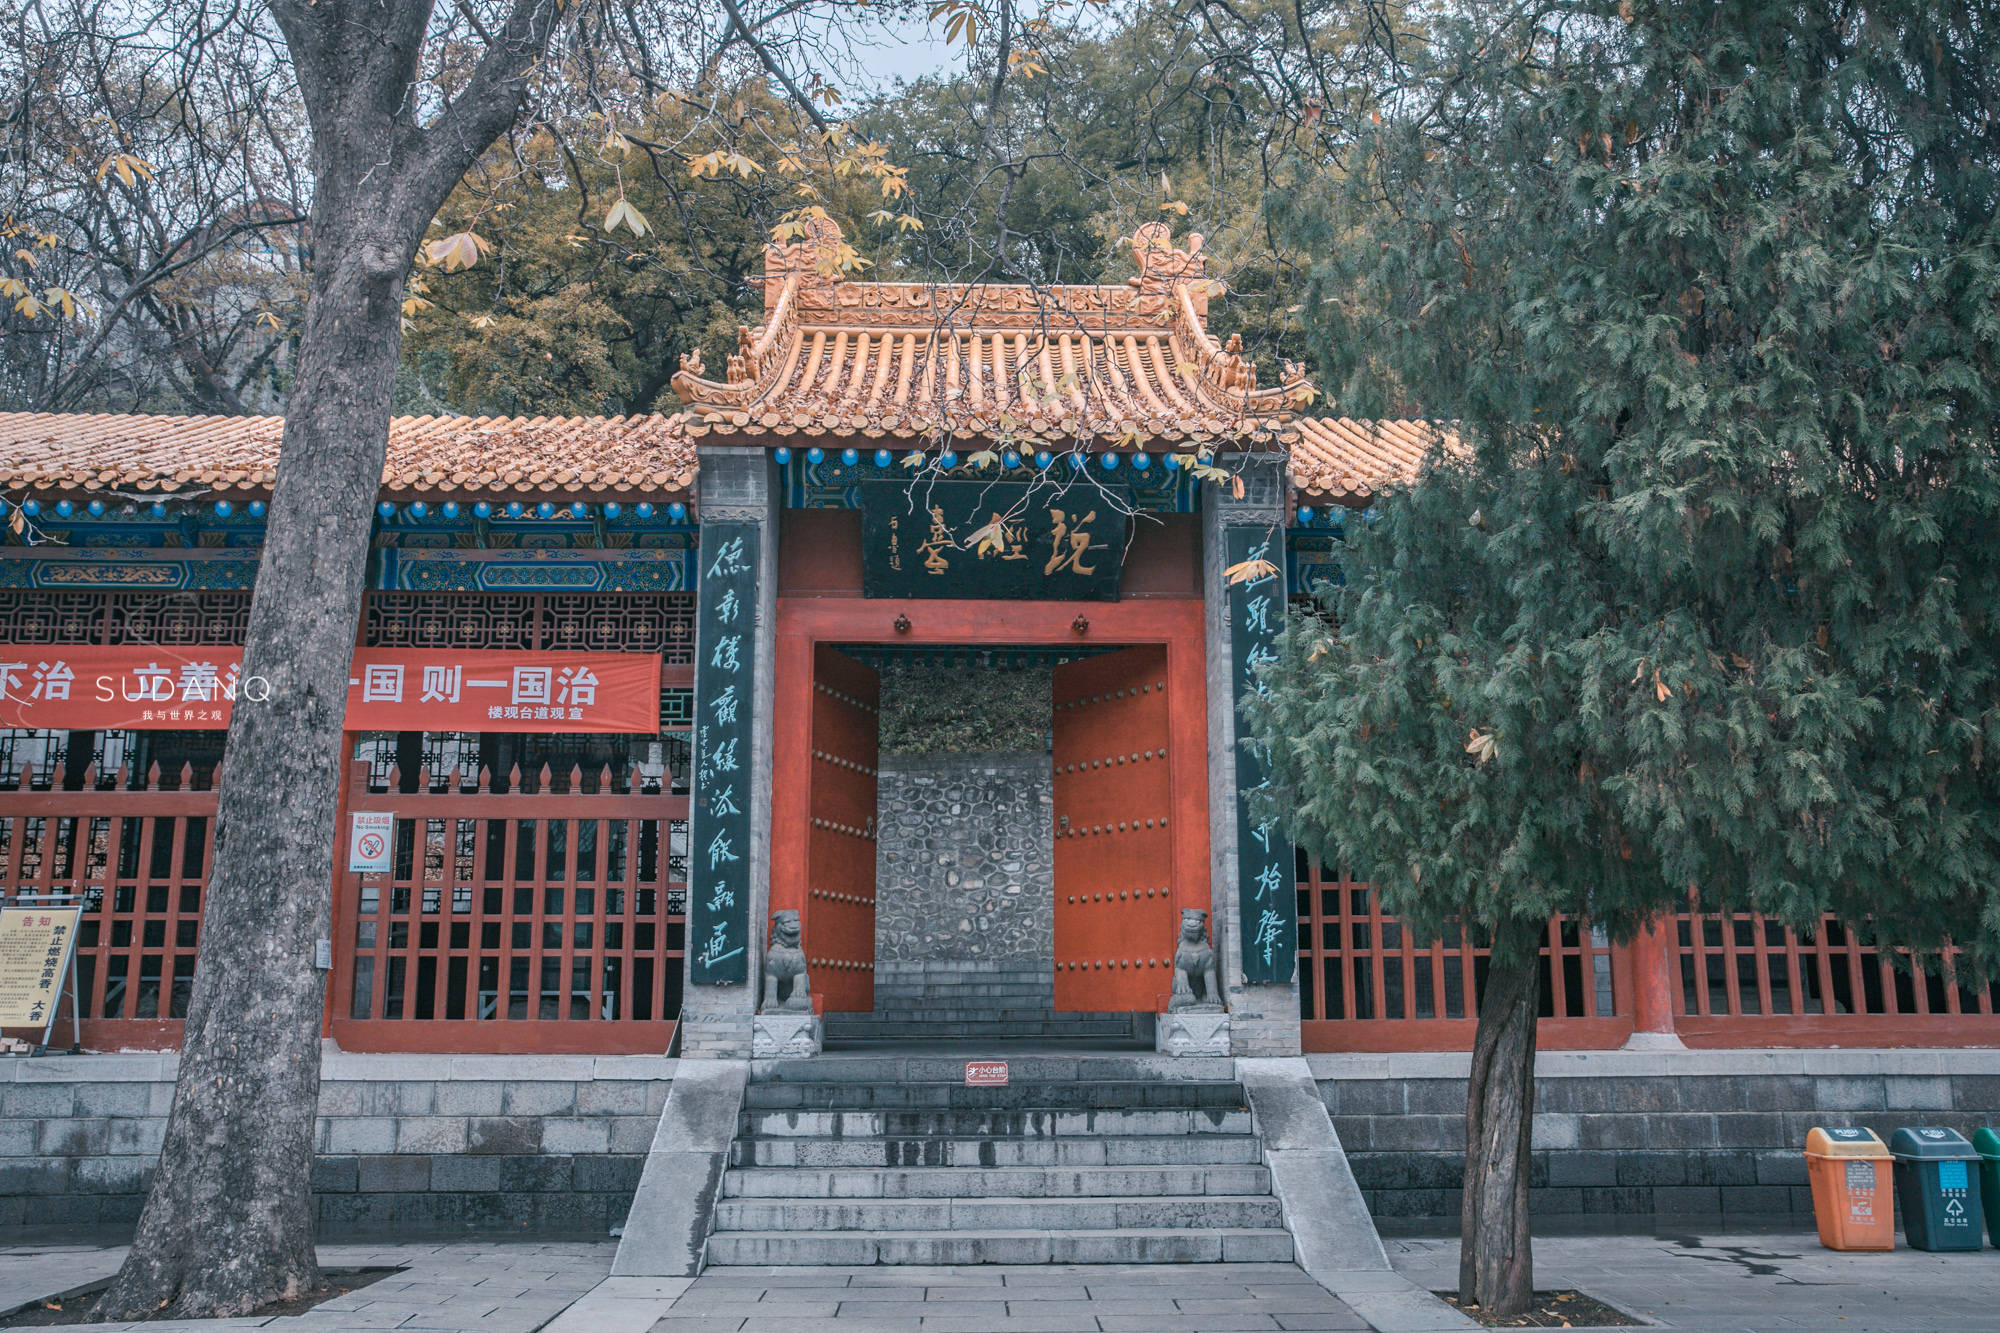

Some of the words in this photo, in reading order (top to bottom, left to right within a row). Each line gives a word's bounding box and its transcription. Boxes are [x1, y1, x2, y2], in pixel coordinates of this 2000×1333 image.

[350, 664, 599, 705] 国则一国治
[22, 915, 51, 927] 告知
